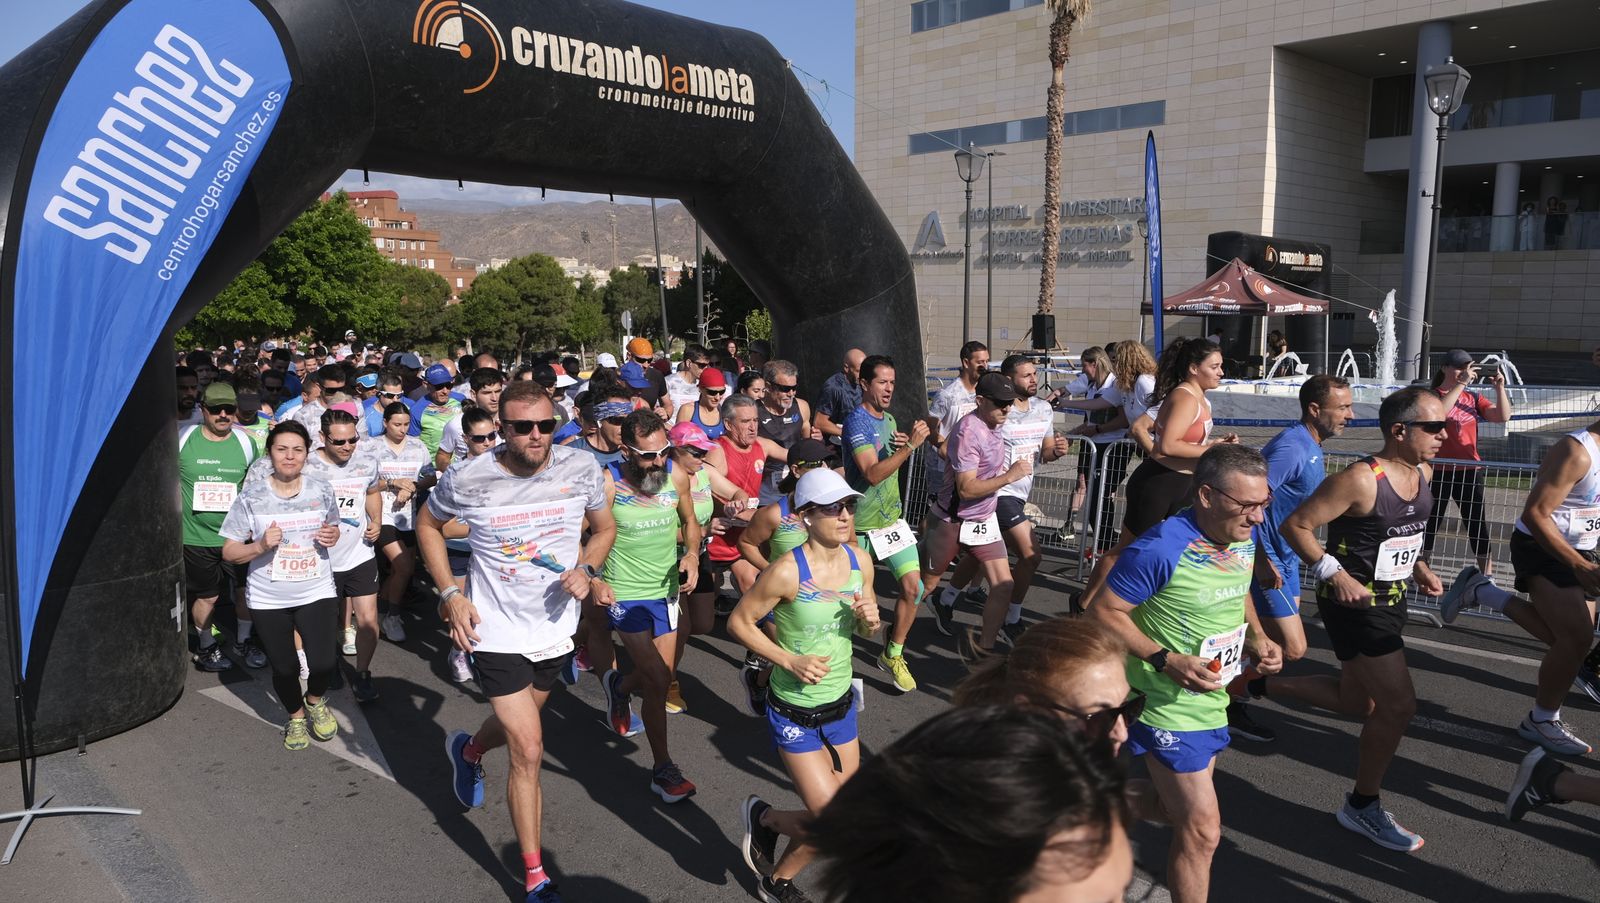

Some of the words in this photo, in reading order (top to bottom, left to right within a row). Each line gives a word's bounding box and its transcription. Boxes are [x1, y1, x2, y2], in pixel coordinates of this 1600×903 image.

[511, 26, 756, 106] cruzandolameta
[696, 100, 755, 123] deportivo
[157, 90, 282, 281] centrohogarsanchez.es
[200, 491, 232, 502] 1211
[635, 516, 673, 530] SAKAT
[972, 523, 987, 535] 45
[885, 531, 901, 545] 38
[279, 557, 317, 571] 1064
[1392, 548, 1417, 566] 197
[1215, 582, 1249, 601] SAKAT
